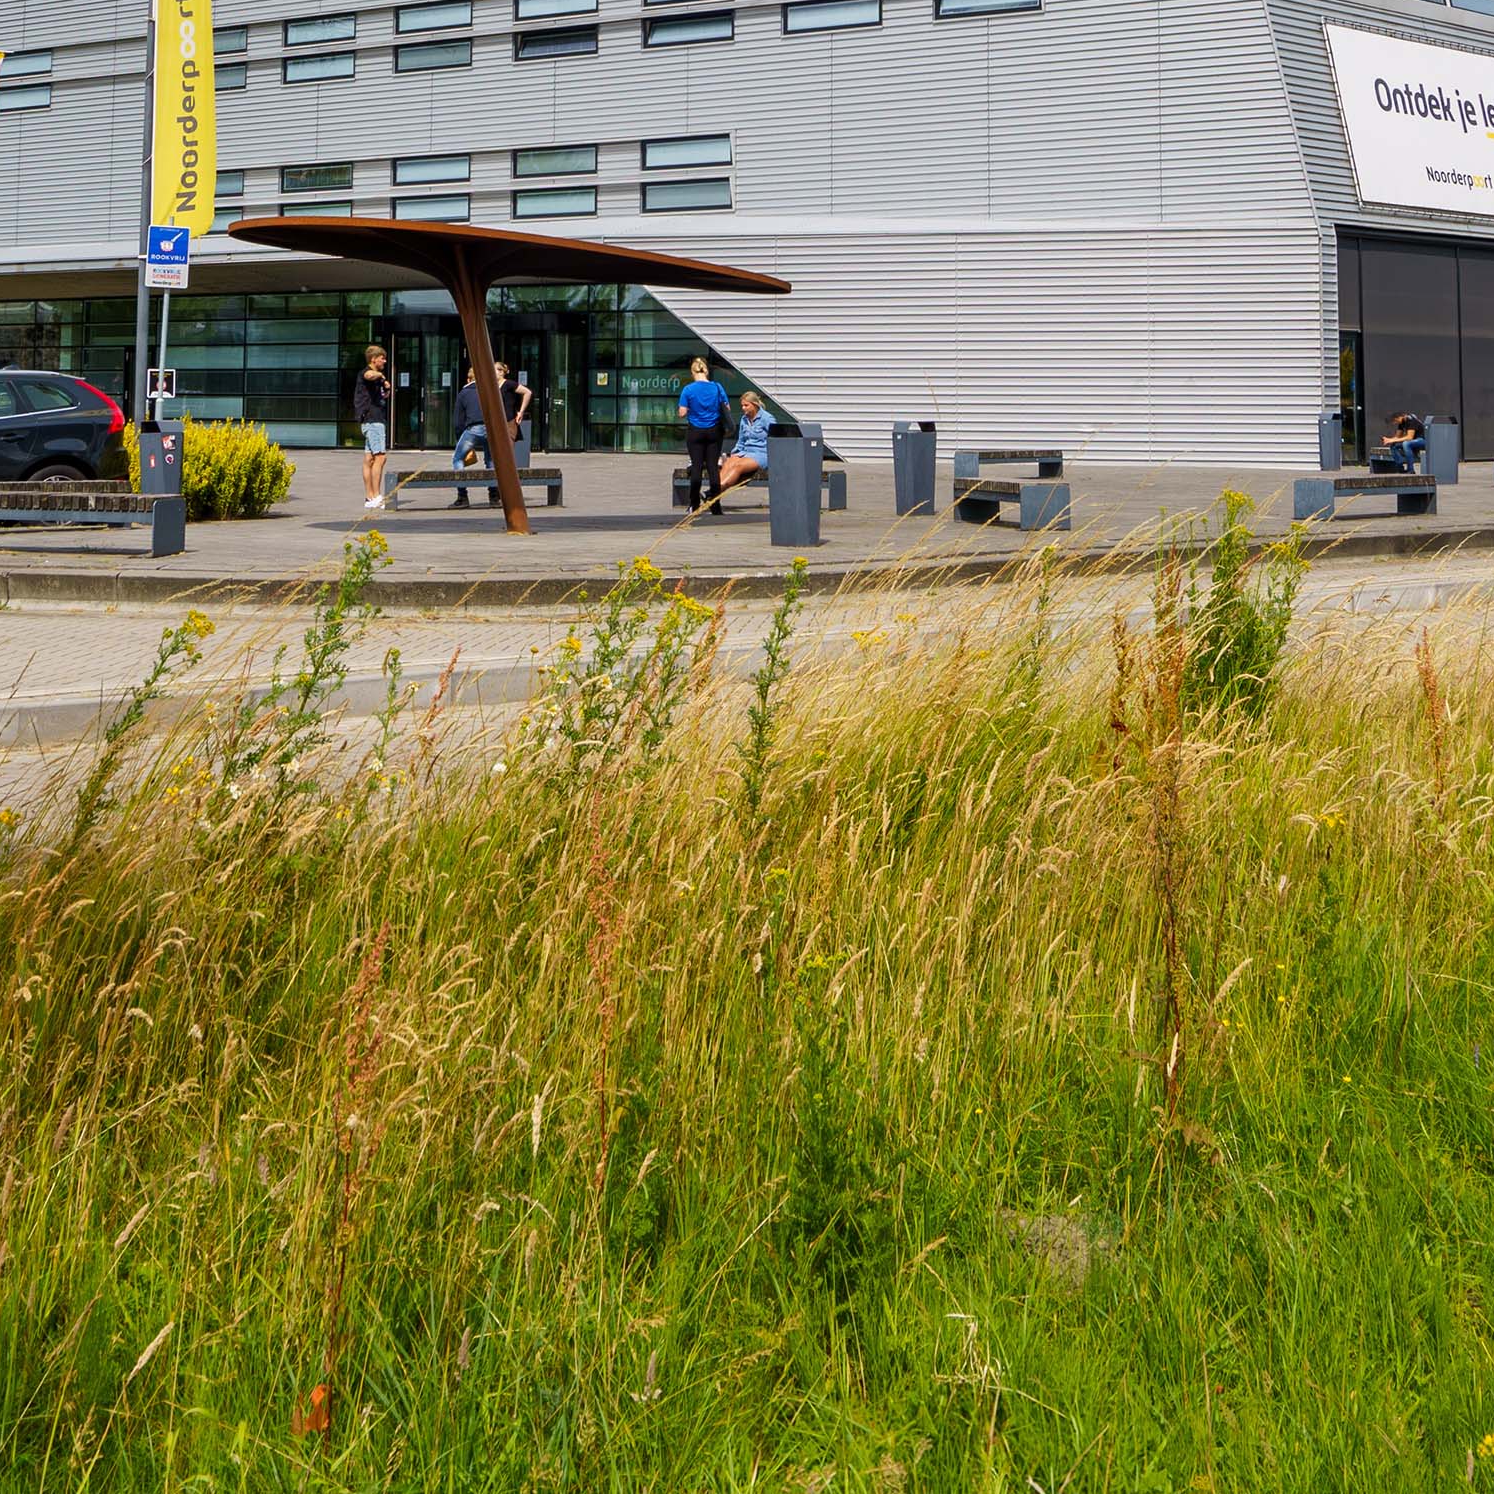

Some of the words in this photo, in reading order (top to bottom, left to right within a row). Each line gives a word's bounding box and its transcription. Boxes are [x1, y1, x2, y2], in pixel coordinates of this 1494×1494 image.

[1374, 78, 1455, 122] Ontdek
[1455, 89, 1477, 133] je
[1425, 166, 1494, 191] Noorderpoort
[150, 254, 185, 262] ROOKVRIJ
[622, 375, 680, 391] Noorderp
